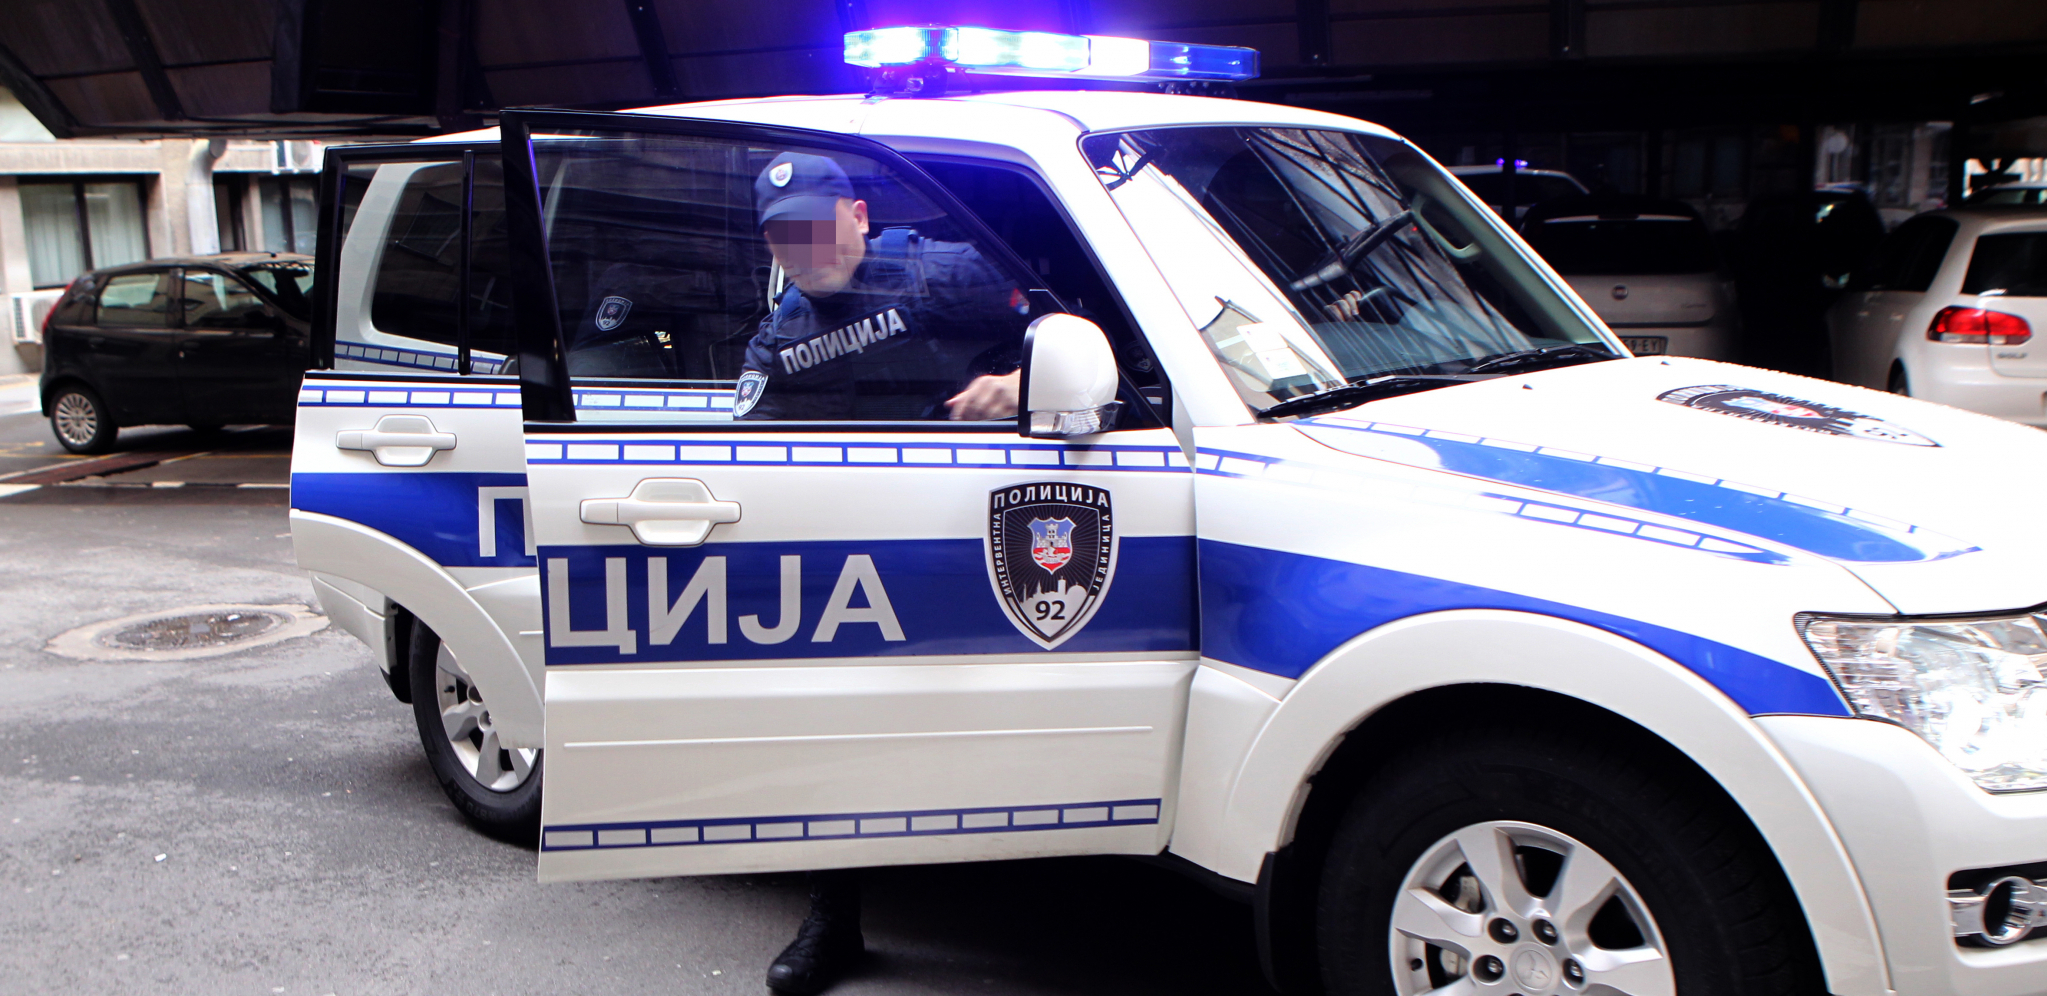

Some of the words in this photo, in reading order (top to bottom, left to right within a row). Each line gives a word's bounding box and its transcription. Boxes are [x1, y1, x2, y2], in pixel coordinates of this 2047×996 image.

[779, 307, 907, 375] ПОЛИЦИЈА
[993, 485, 1110, 510] ПОЛИЦИЈА
[993, 512, 1013, 596] ИНТЕРВЕНТНА
[1092, 513, 1112, 591] ЈЕДИНИЦА
[546, 554, 907, 655] ЦИЈА
[1035, 600, 1066, 621] 92
